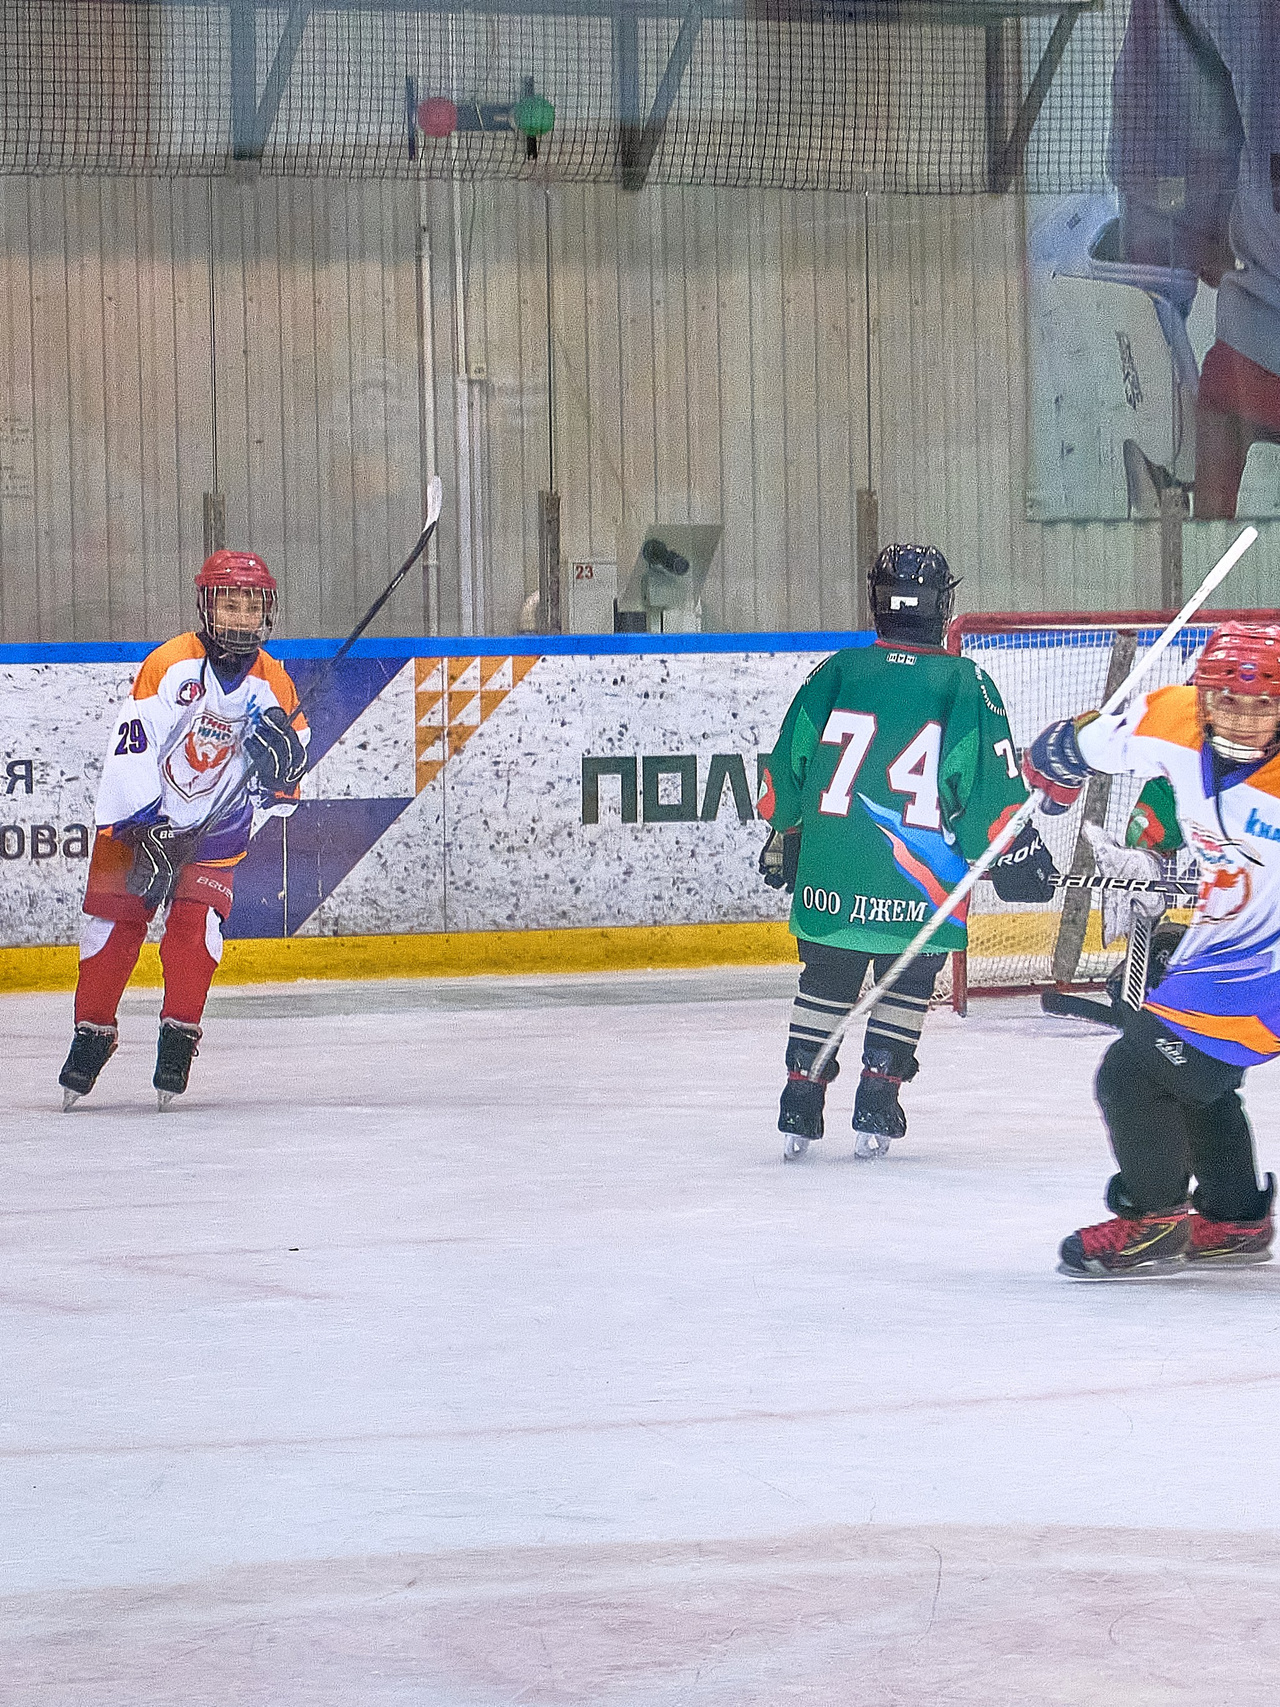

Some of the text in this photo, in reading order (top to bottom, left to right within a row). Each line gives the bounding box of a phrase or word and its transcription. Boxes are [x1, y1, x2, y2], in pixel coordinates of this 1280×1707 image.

[575, 565, 593, 580] 23
[114, 719, 147, 756] 29
[818, 708, 942, 829] 74
[582, 753, 770, 824] ПОЛ
[803, 886, 928, 925] ООО ДЖЕМ
